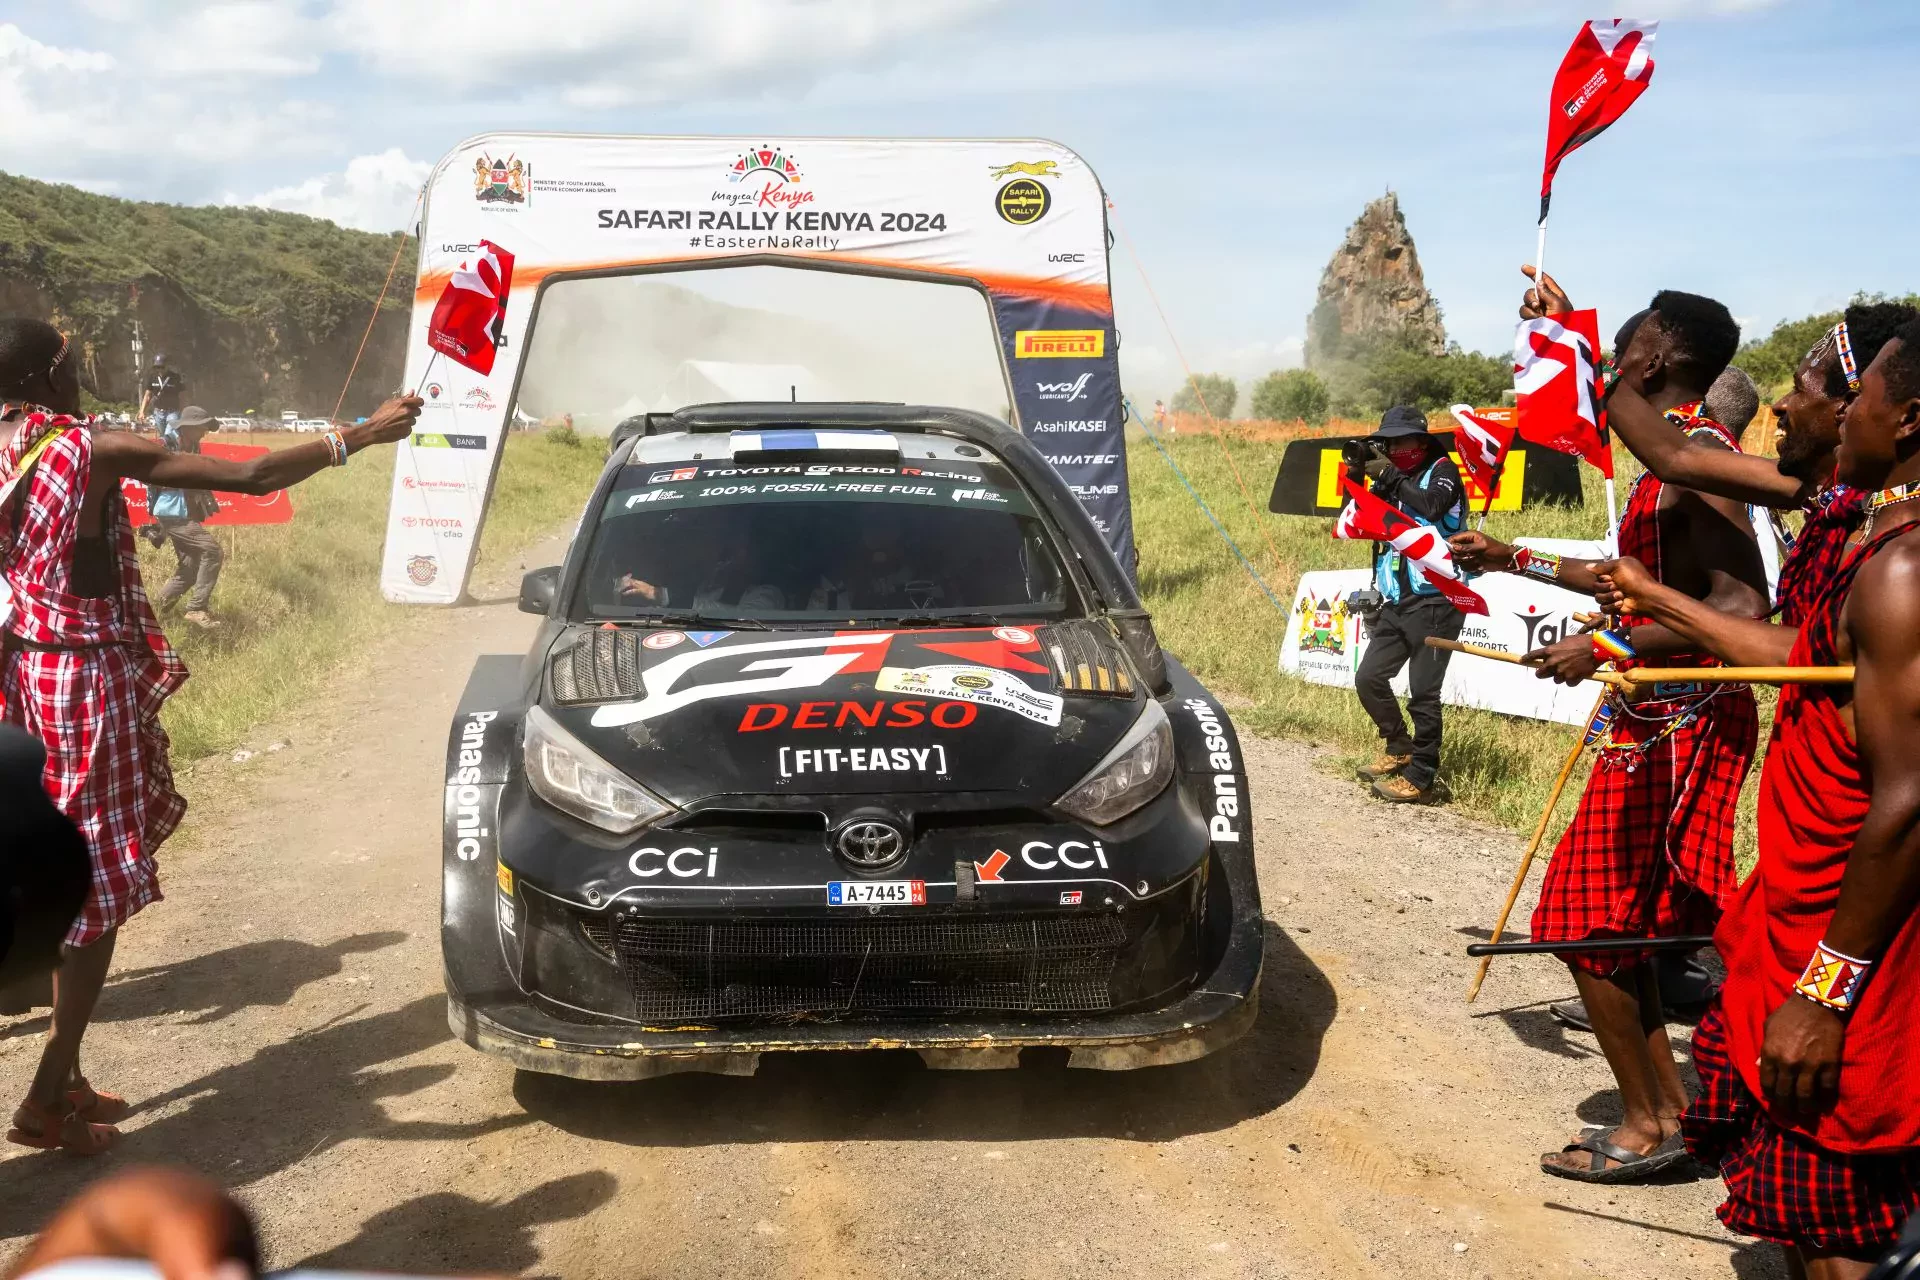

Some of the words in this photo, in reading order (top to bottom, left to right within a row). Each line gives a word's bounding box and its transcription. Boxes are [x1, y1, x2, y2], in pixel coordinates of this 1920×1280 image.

[1567, 95, 1585, 117] GR
[758, 181, 815, 209] Kenya
[598, 209, 691, 230] SAFARI
[699, 210, 780, 231] RALLY
[785, 211, 875, 231] KENYA
[880, 212, 947, 232] 2024
[442, 243, 479, 252] WRC
[689, 234, 840, 251] #EasterNaRally
[1048, 253, 1085, 262] WRC
[1024, 335, 1097, 353] PIRELLI
[456, 438, 476, 446] BANK
[649, 469, 697, 483] GR
[703, 466, 801, 477] TOYOTA
[806, 465, 896, 475] GAZOO
[901, 466, 982, 483] Racing
[699, 485, 757, 497] 100%
[761, 484, 887, 493] FOSSIL-FREE
[889, 485, 937, 496] FUEL
[419, 518, 463, 527] TOYOTA
[1461, 627, 1490, 640] FAIRS,
[1299, 660, 1323, 669] REPUBLIC
[1332, 664, 1350, 672] KENYA
[893, 684, 935, 695] SAFARI
[938, 688, 974, 699] RALLY
[977, 694, 1016, 709] KENYA
[1019, 705, 1049, 721] 2024
[738, 700, 979, 733] DENSO
[1183, 698, 1240, 842] Panasonic
[456, 710, 499, 861] Panasonic
[847, 885, 906, 901] A-7445
[912, 883, 921, 891] 11
[912, 893, 922, 902] 24
[1061, 893, 1081, 904] GR
